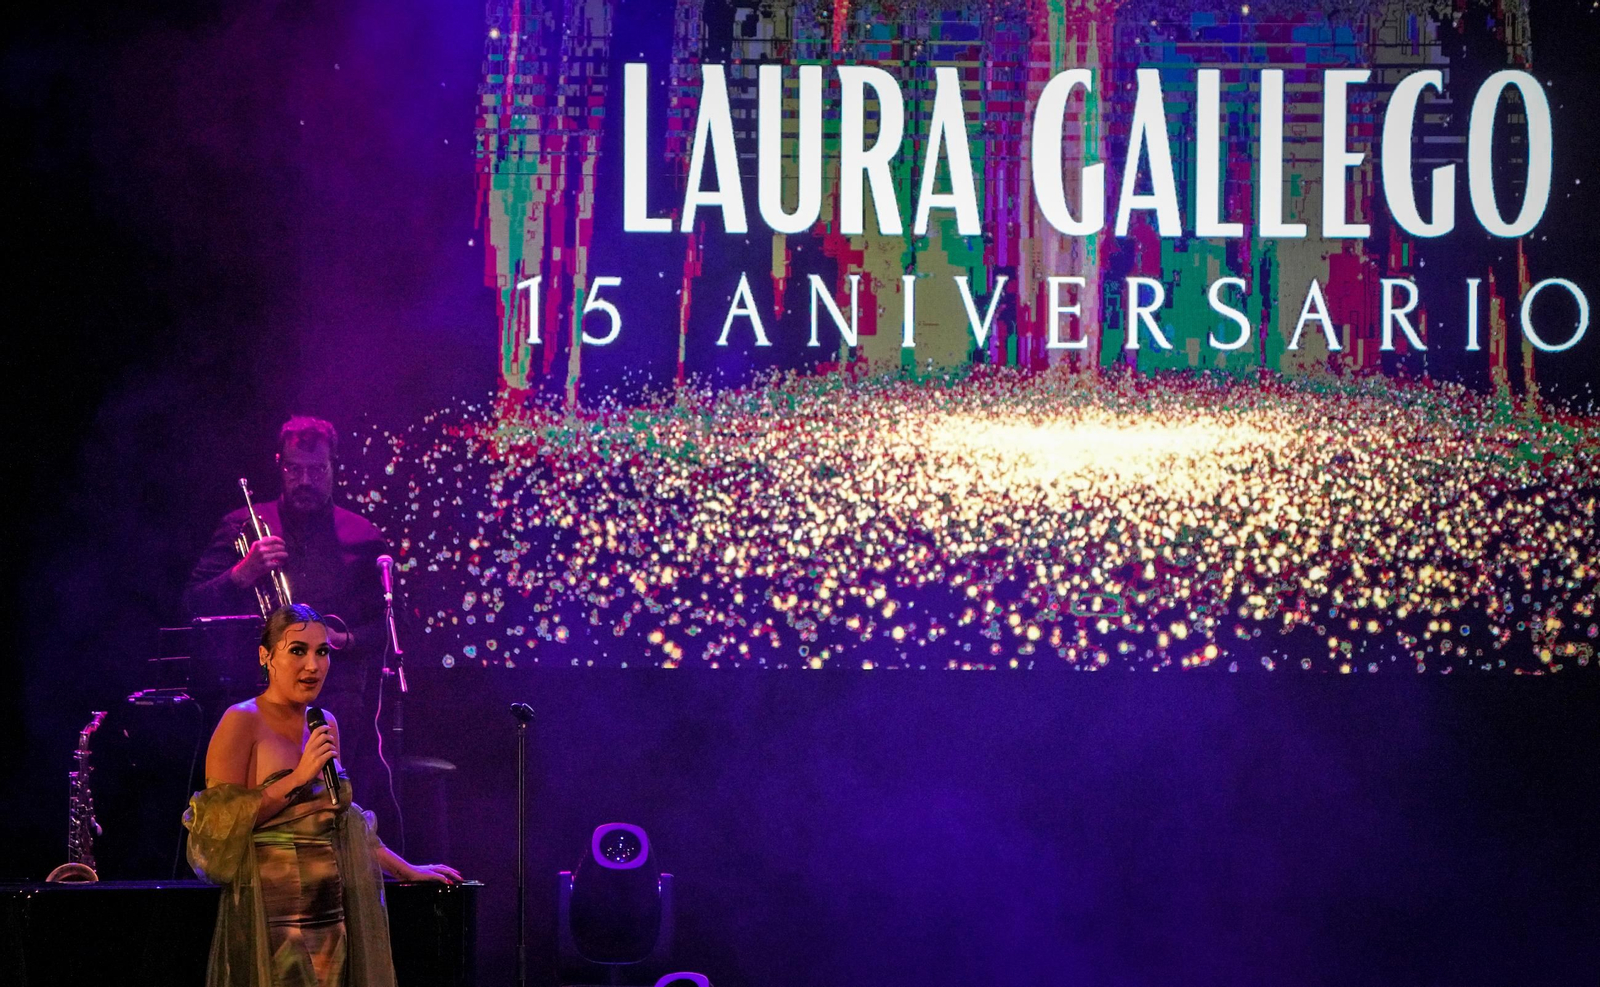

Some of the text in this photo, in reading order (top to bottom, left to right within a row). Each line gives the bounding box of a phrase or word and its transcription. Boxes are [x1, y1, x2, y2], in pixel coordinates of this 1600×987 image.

[624, 63, 1553, 238] LAURA GALLEGO
[516, 272, 1589, 351] 15 ANIVERSARIO
